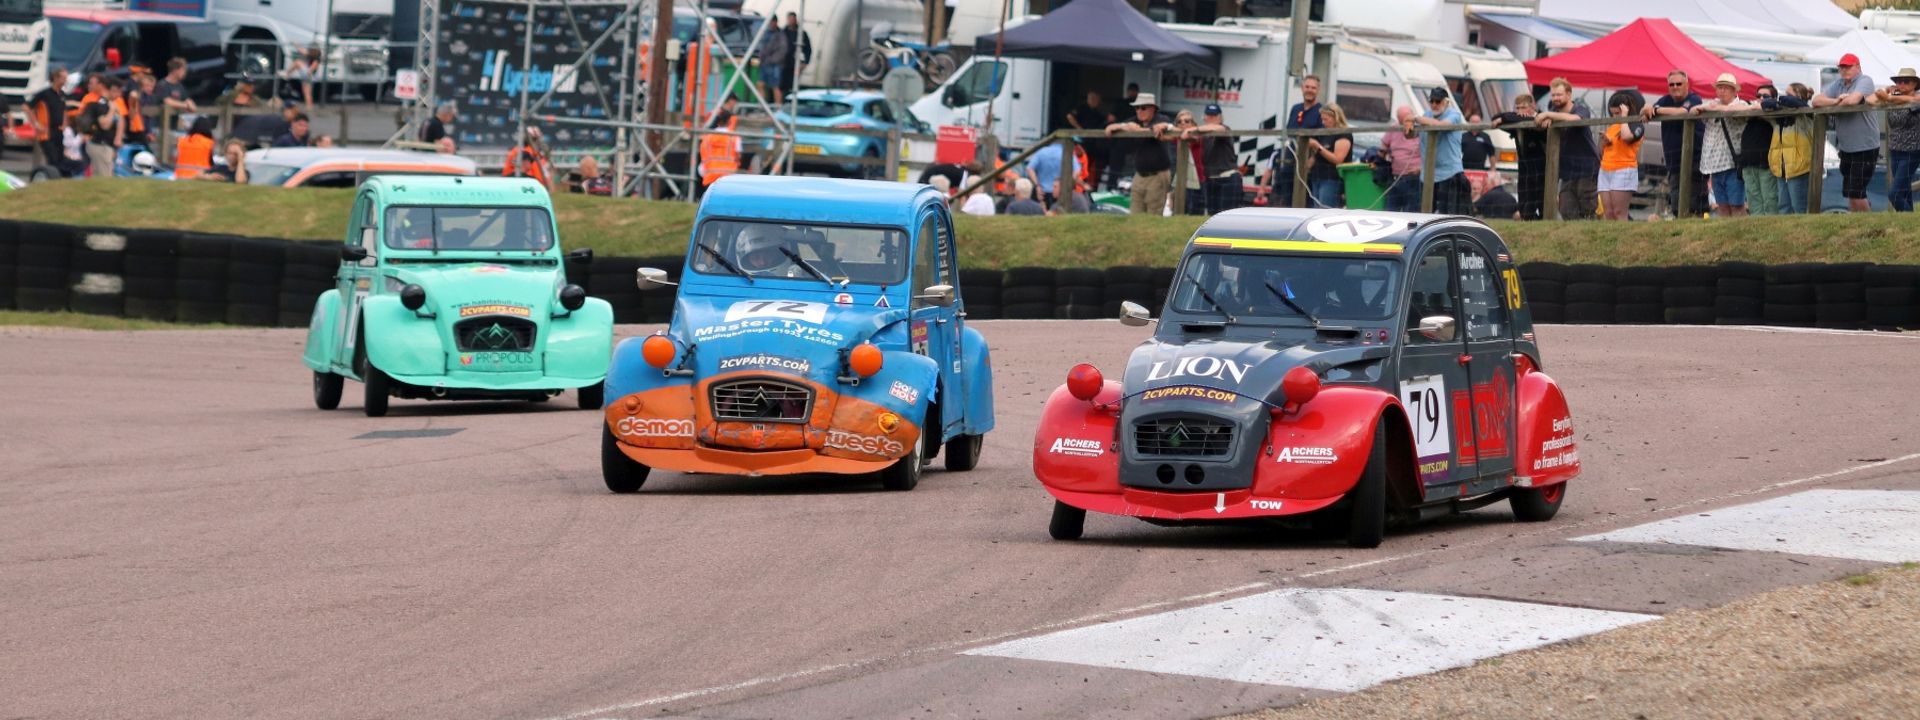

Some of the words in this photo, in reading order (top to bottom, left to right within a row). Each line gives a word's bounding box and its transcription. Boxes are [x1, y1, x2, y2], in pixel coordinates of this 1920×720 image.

[1323, 219, 1393, 237] 79
[1502, 268, 1521, 311] 79
[461, 306, 529, 316] 2CVPARTS.COM
[747, 301, 808, 314] 72
[695, 320, 774, 337] Master
[781, 320, 844, 342] Tyres
[476, 352, 533, 364] PROPOLIS
[720, 355, 809, 372] 2CVPARTS.COM
[1144, 356, 1254, 384] LION
[1143, 387, 1237, 403] 2CVPARTS.COM
[1410, 387, 1439, 445] 79
[617, 416, 694, 437] demon
[1049, 437, 1102, 453] ARCHERS
[1276, 447, 1334, 463] ARCHERS
[1251, 500, 1282, 510] TOW
